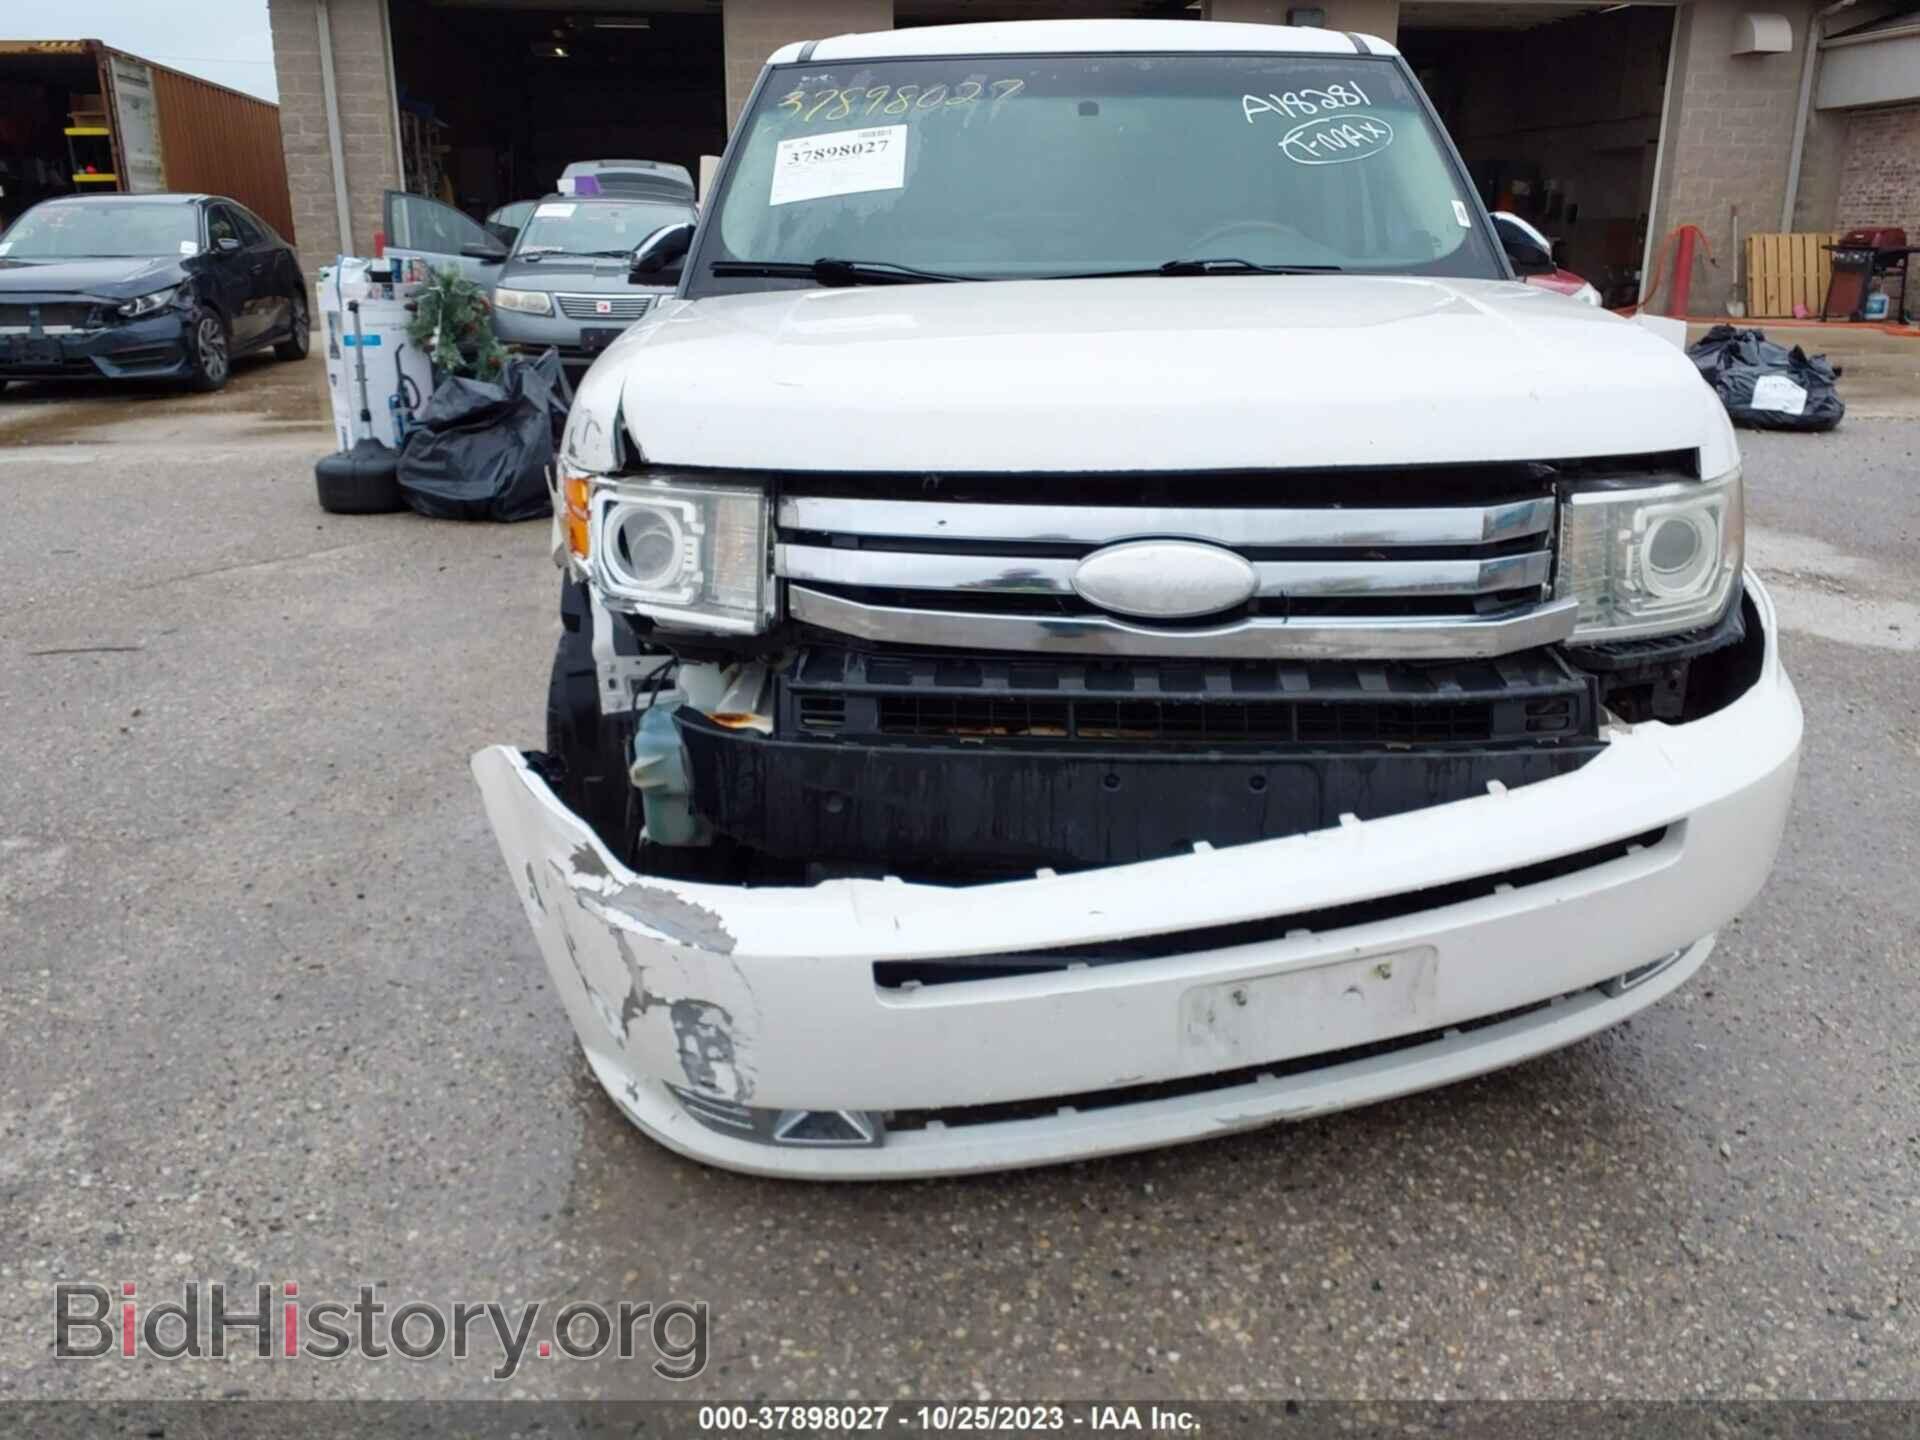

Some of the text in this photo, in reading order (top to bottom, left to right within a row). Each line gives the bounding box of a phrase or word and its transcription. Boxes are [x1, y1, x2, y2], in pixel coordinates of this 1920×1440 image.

[778, 79, 1024, 122] 37898027
[1243, 81, 1371, 123] A18281
[790, 140, 890, 164] 37898027
